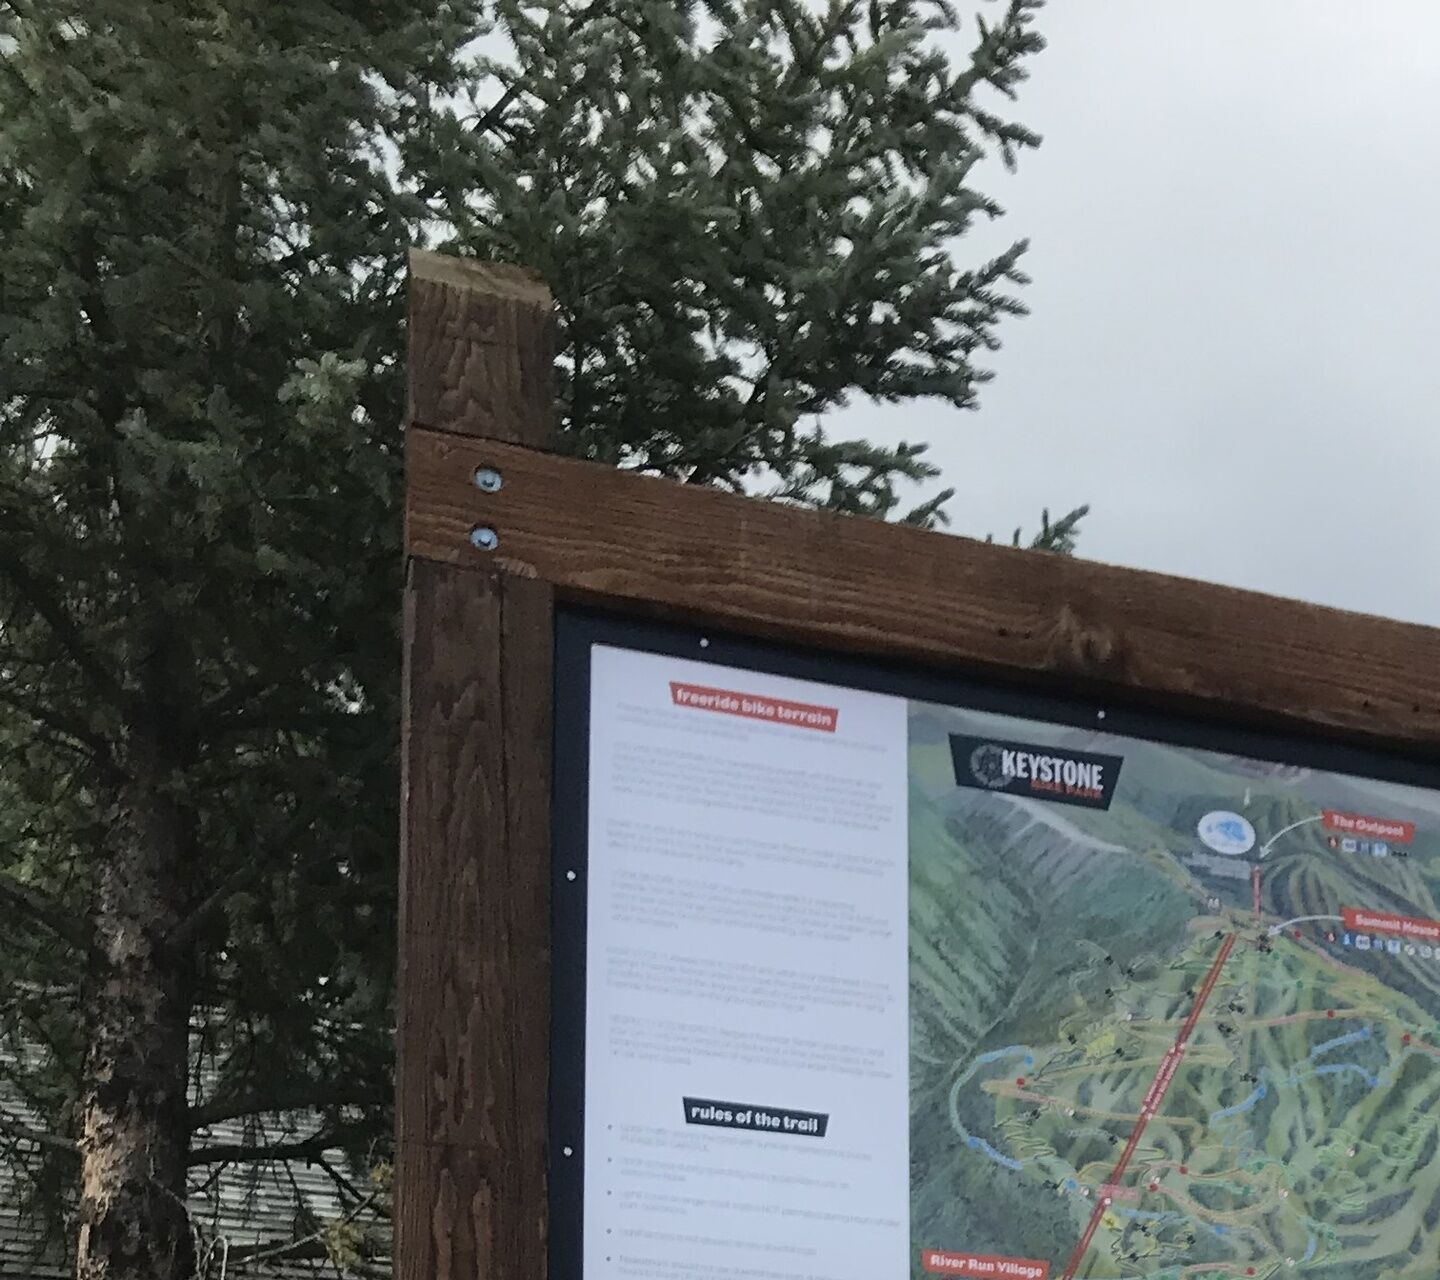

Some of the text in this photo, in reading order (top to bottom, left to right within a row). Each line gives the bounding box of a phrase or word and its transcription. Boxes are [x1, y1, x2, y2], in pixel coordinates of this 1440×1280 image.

[676, 688, 833, 726] freeride bike terrain
[1002, 749, 1104, 791] KEYSTONE
[691, 1105, 819, 1132] rules of the trail
[930, 1254, 1044, 1279] River Run Village
